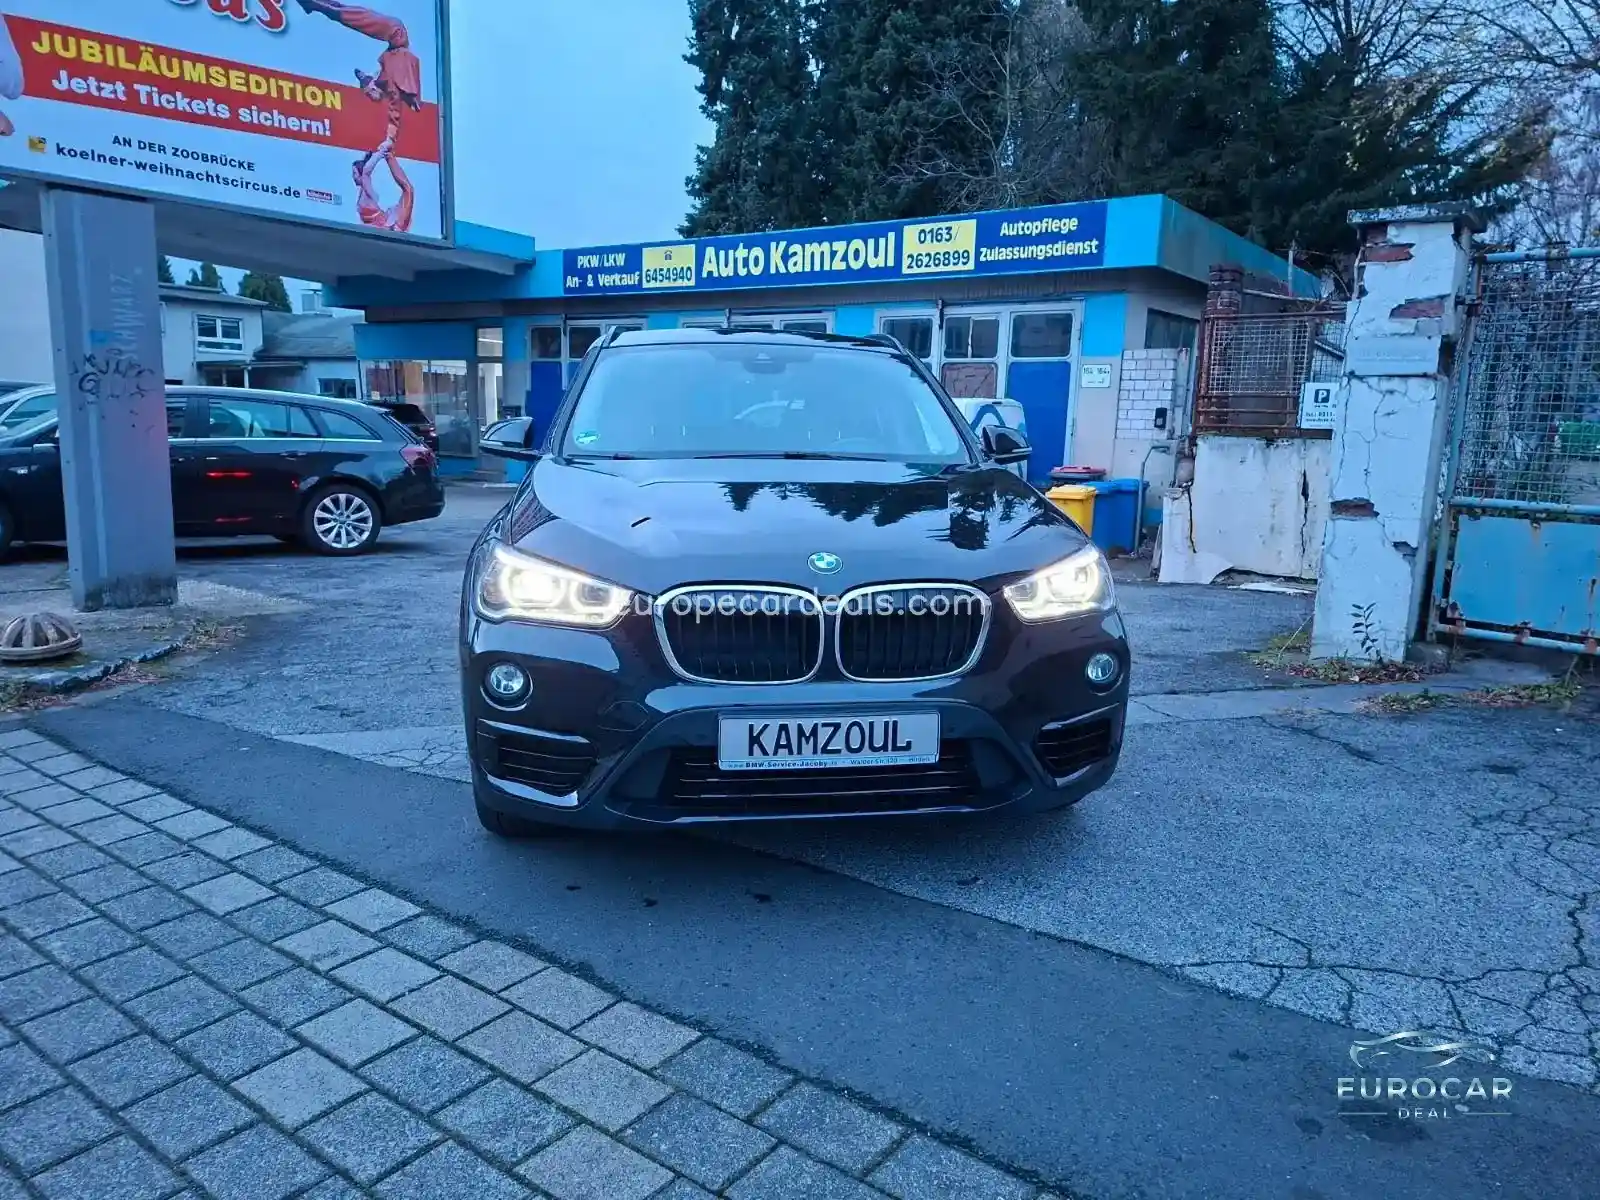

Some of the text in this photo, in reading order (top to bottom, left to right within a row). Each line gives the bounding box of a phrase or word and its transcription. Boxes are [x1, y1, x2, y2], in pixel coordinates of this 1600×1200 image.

[31, 31, 342, 110] JUBILÄUMSEDITION
[52, 69, 331, 136] Jetzt Tickets sichern!
[112, 135, 255, 172] AN DER ZOOBRÜCKE
[56, 143, 300, 199] koelner-weihnachtscircus.de
[918, 224, 960, 244] 0163/
[1000, 217, 1078, 237] Autopflege
[577, 253, 626, 269] PKW/LKW
[702, 231, 896, 278] Auto Kamzoul
[906, 250, 970, 270] 2626899
[979, 238, 1099, 262] Zulassungsdienst
[566, 271, 640, 288] An- & Verkauf
[645, 266, 692, 284] 6454940
[748, 719, 913, 757] KAMZOUL
